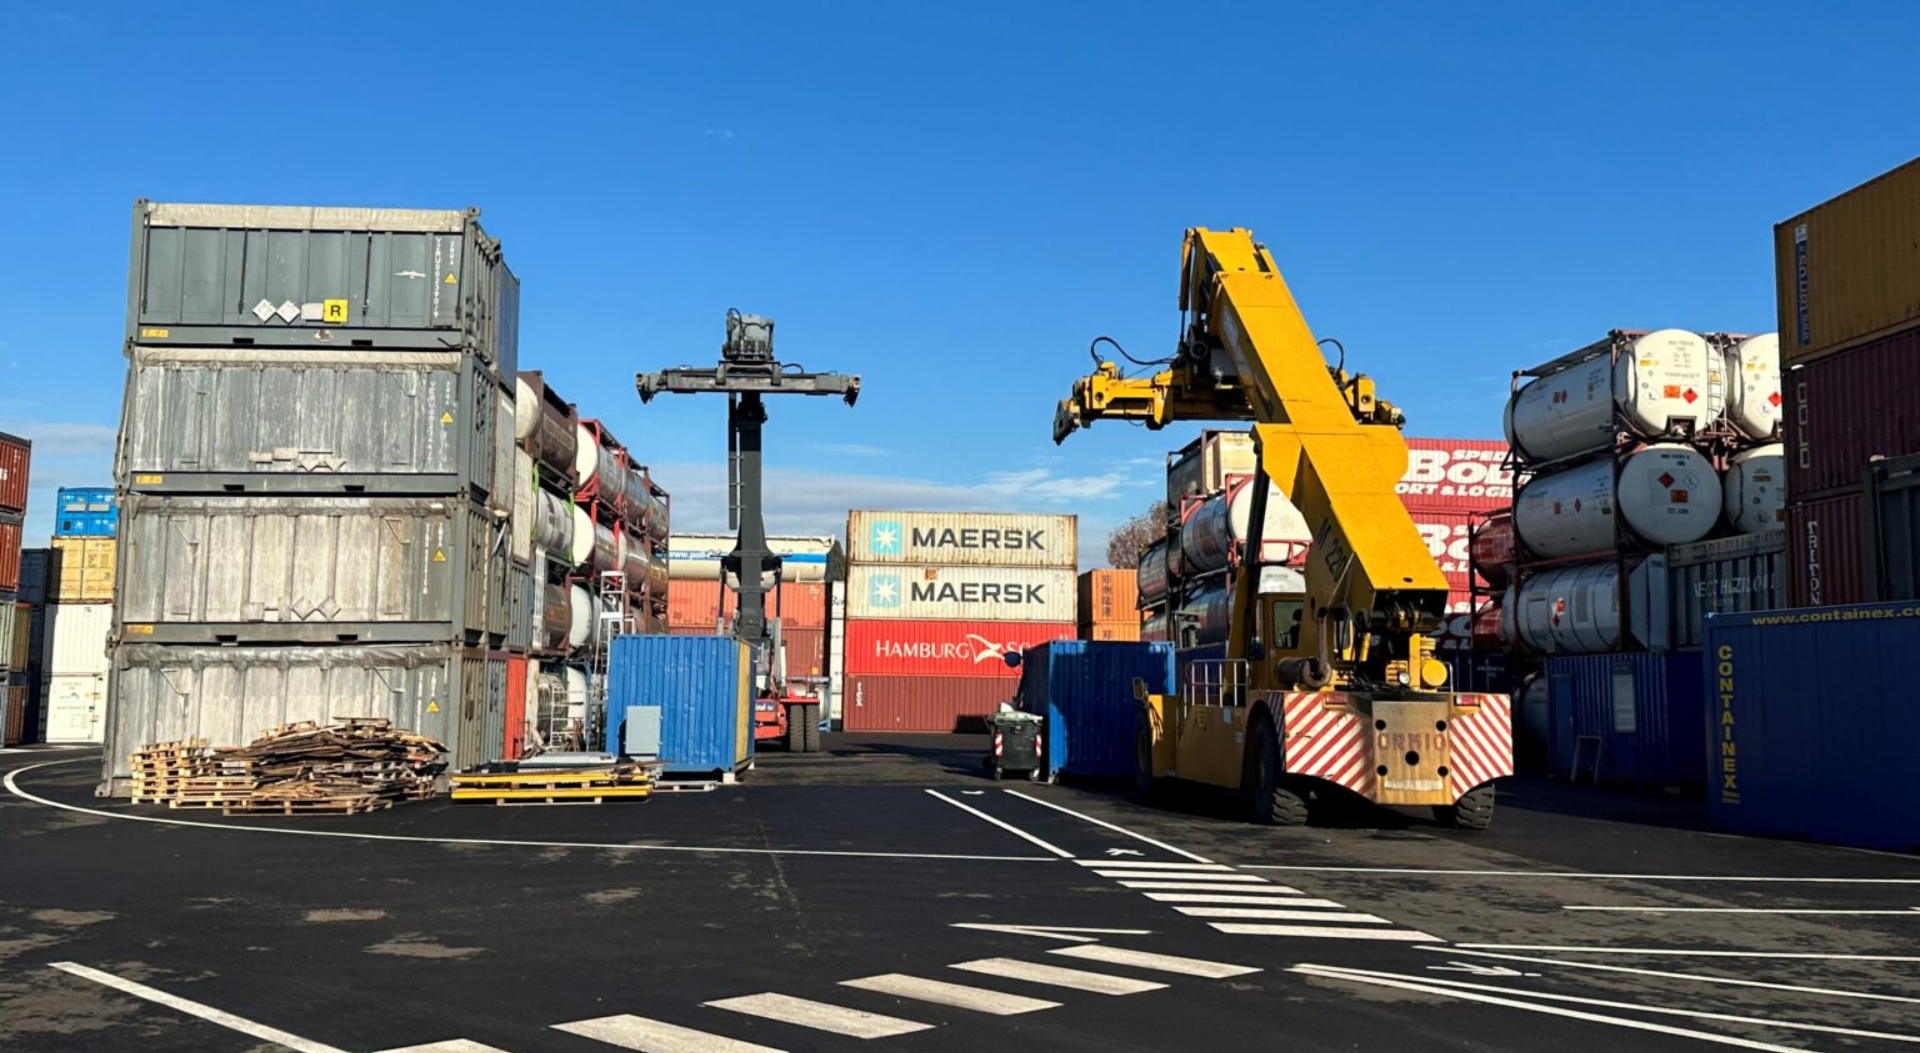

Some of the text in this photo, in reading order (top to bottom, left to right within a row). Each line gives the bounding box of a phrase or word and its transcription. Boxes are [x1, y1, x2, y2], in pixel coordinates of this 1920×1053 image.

[330, 305, 341, 316] R
[912, 527, 1046, 550] MAERSK
[1807, 521, 1821, 606] TRITON
[911, 581, 1046, 604] MAERSK
[876, 640, 970, 658] HAMBURG
[1718, 646, 1737, 789] CONTAINEX
